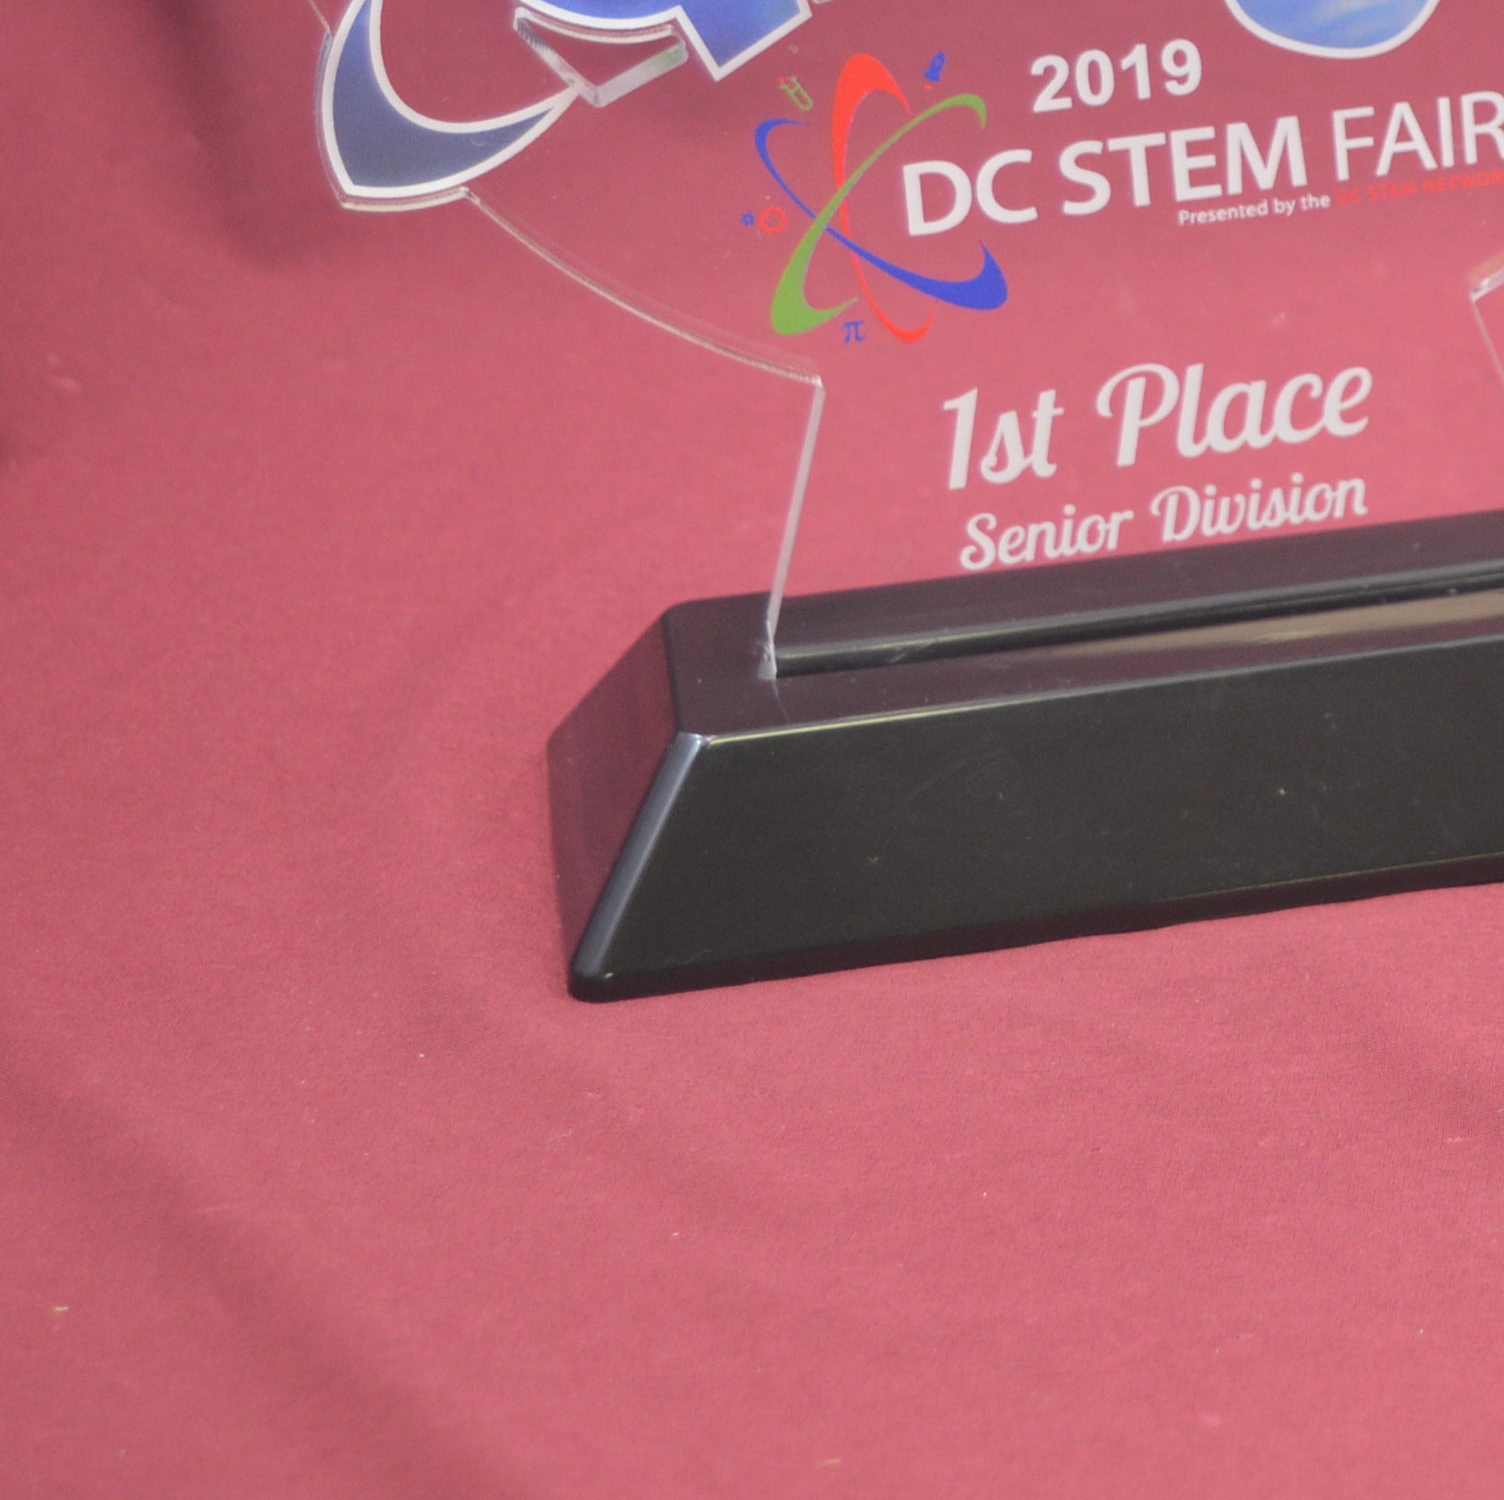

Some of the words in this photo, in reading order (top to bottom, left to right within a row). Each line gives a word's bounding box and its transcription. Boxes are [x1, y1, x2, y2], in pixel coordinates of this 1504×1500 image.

[1031, 39, 1201, 112] 2019
[903, 150, 1037, 235] DC
[1059, 116, 1308, 217] STEM
[1179, 201, 1268, 224] Presented
[1273, 198, 1295, 215] by
[1300, 194, 1330, 210] the
[1335, 188, 1360, 205] DC
[1367, 182, 1416, 200] STEM
[944, 389, 1063, 489] 1st
[1097, 359, 1372, 466] Place
[959, 504, 1134, 571] Senior
[1150, 472, 1368, 542] Division
